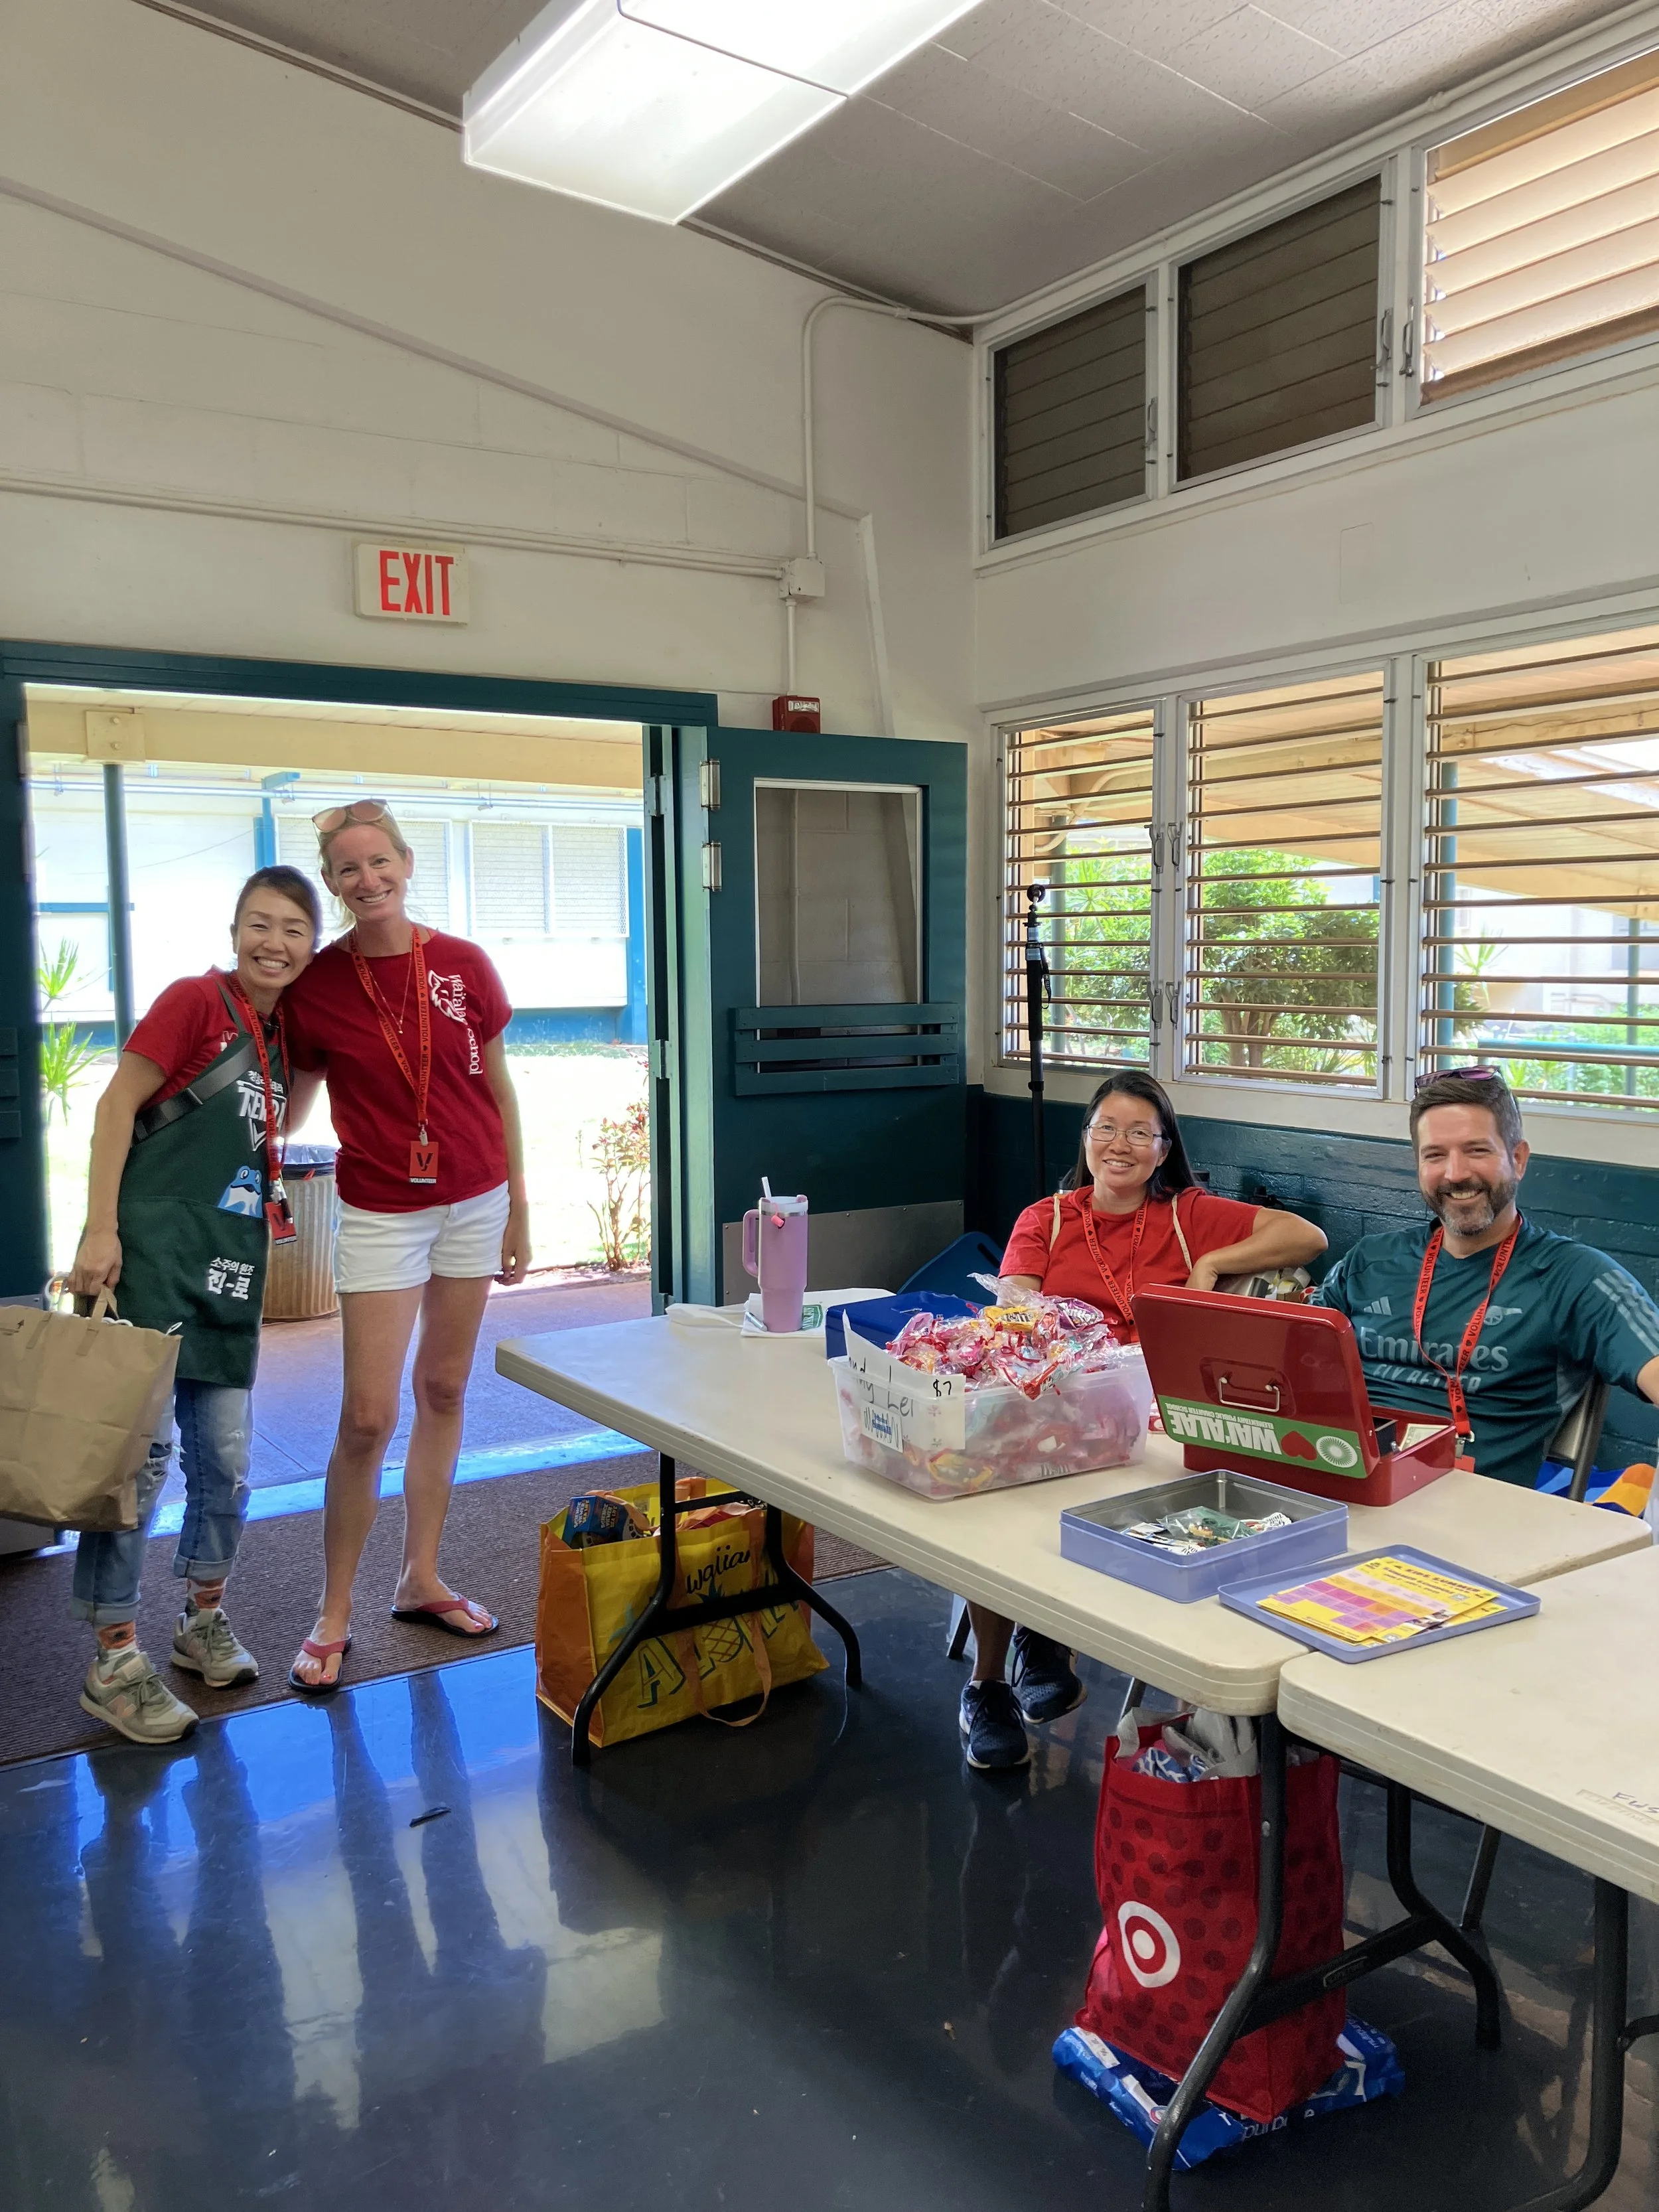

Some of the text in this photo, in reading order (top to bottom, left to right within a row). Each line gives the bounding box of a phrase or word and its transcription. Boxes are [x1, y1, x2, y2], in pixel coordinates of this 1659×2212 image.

[380, 550, 455, 616] EXIT
[419, 1001, 429, 1042] VOLUNTEER
[419, 1054, 429, 1096] VOLUNTEER
[210, 1256, 240, 1273] 소주의
[1089, 1238, 1108, 1273] VOLUNTEER
[1420, 1251, 1435, 1294] VOLUNTEER
[1108, 1280, 1131, 1317] VOLUNTEER
[1468, 1299, 1486, 1337] VOLUNT
[1360, 1326, 1509, 1372] Emiraes
[1165, 1402, 1274, 1430] ELEMENTARY PUBLIC CHARTER SCHOOL
